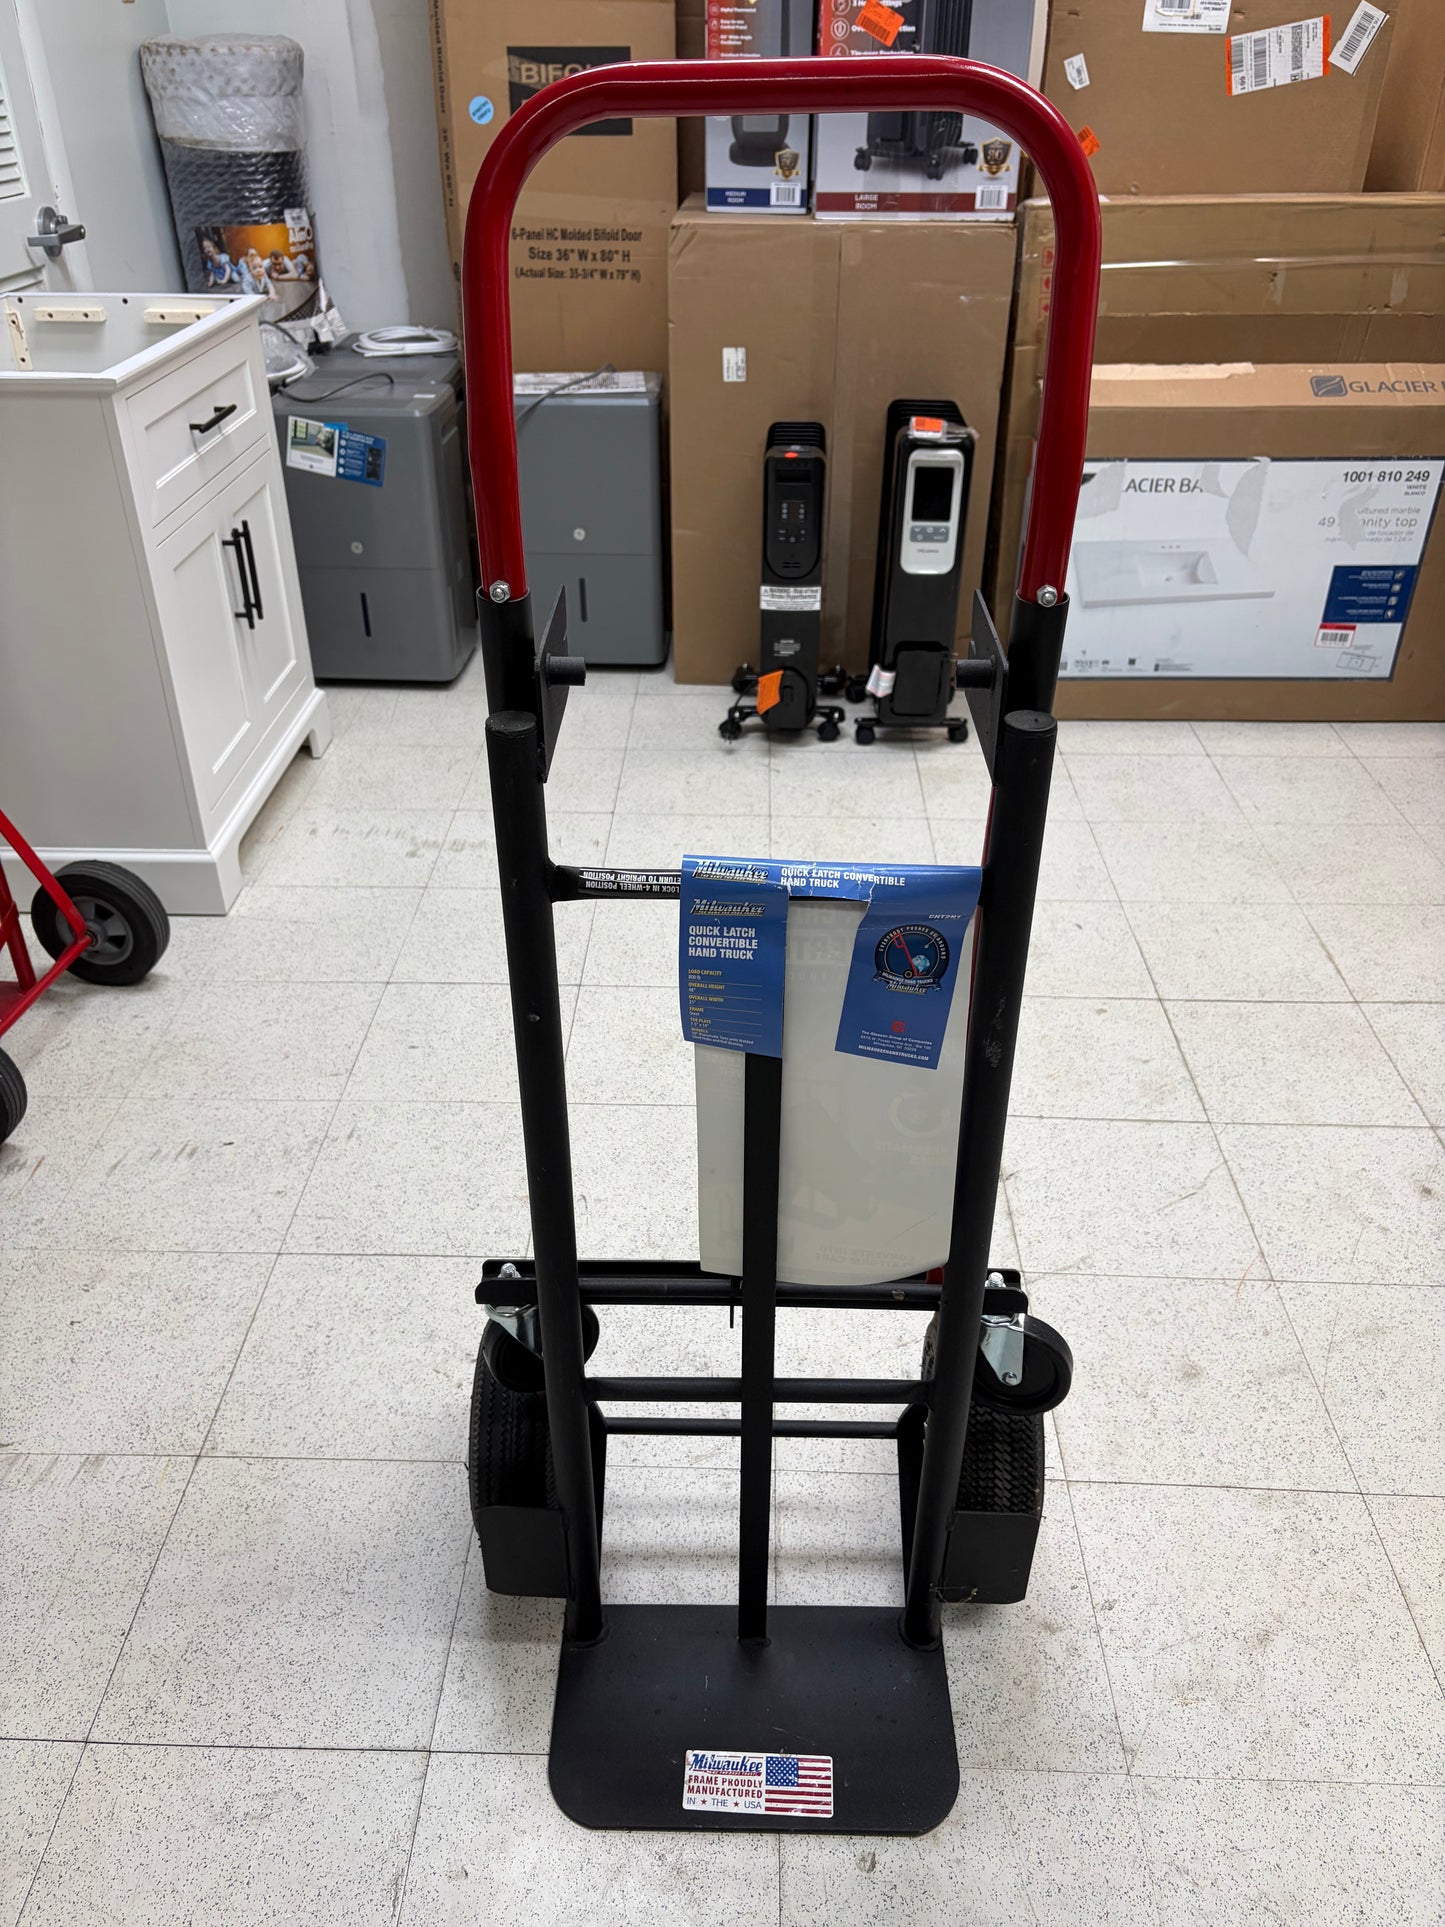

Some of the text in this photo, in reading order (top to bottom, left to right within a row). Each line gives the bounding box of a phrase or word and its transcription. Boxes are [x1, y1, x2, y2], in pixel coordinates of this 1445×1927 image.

[854, 194, 879, 202] LARGE
[855, 202, 878, 210] ROOM
[512, 227, 642, 241] 6-Panel HC Molded Bifold Door
[528, 247, 552, 260] Size
[578, 250, 588, 262] W
[622, 251, 631, 262] H
[1349, 380, 1438, 393] GLACIER
[1343, 470, 1430, 483] 1001 810 249
[1357, 505, 1422, 515] ultured marble
[1318, 516, 1336, 528] 49
[1395, 515, 1418, 528] top
[583, 871, 615, 880] POSITION
[693, 860, 769, 879] Milwaukee
[616, 873, 647, 882] UPRIGHT
[781, 867, 906, 887] QUICK LATCH CONVERTIBLE
[781, 877, 840, 889] HAND TRUCK
[585, 880, 680, 893] LOCK IN 4-WHEEL POSITION
[690, 899, 766, 914] Milwaukee
[688, 925, 756, 938] QUICK LATCH
[688, 936, 758, 949] CONVERTIBLE
[688, 947, 754, 960] HAND TRUCK
[689, 1753, 763, 1772] Milwaukee
[688, 1774, 763, 1789] FRAME PROUDLY
[686, 1784, 763, 1799] MANUFACTURED
[686, 1797, 762, 1809] IN THE USA
